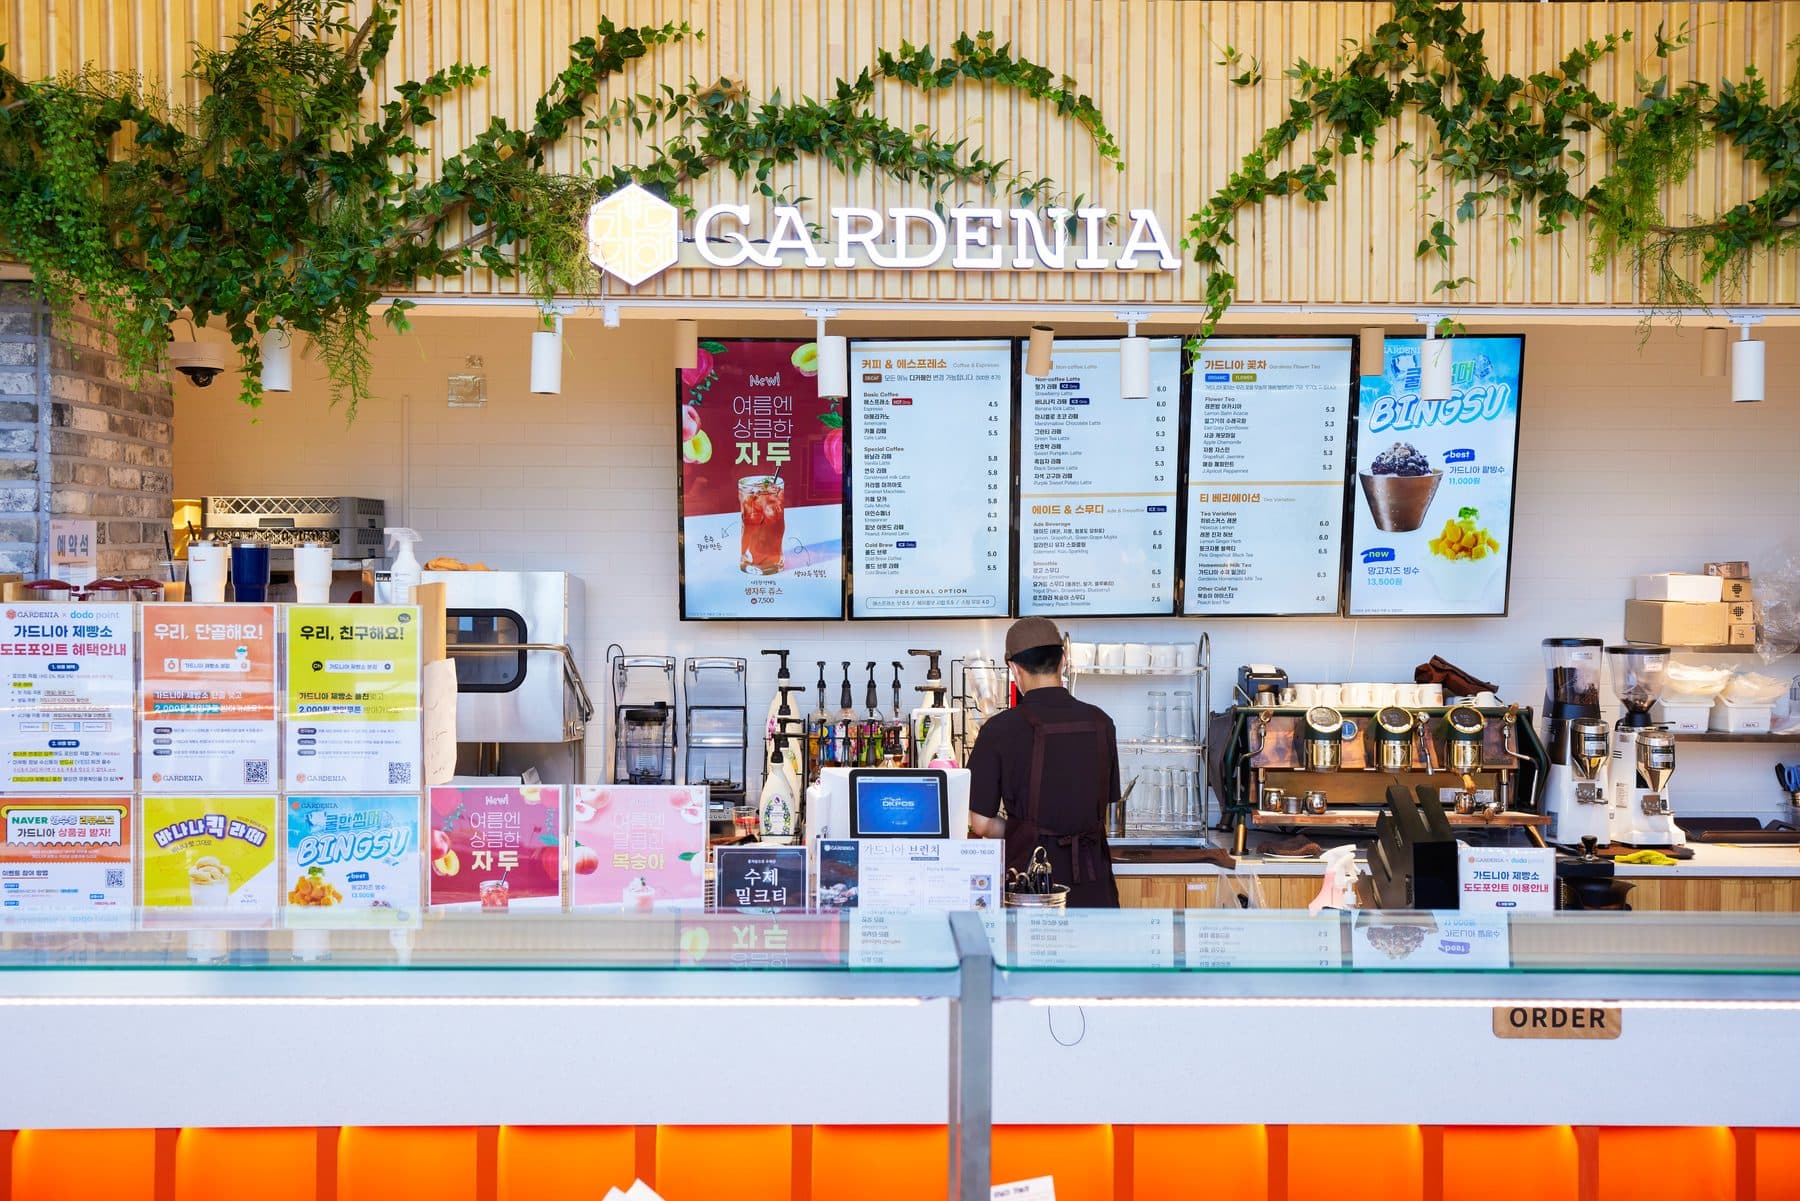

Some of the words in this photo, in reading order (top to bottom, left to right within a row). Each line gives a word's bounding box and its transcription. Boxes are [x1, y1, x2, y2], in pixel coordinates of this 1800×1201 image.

[694, 203, 1182, 271] GARDENIA
[862, 359, 881, 369] 커피
[884, 360, 893, 369] &
[896, 359, 947, 369] 에스프레소
[1205, 360, 1244, 370] 가드니아
[1247, 360, 1267, 370] 꽃차
[733, 395, 793, 416] 여름엔
[1369, 383, 1512, 433] BINGSU
[732, 418, 794, 440] 상큼한
[735, 441, 792, 467] 자두
[1449, 449, 1470, 458] best
[1449, 465, 1480, 475] 가드니아
[1199, 493, 1209, 503] 티
[1212, 493, 1261, 503] 베리에이션
[1032, 505, 1061, 514] 에이드
[1074, 504, 1104, 514] 스무디
[1369, 550, 1390, 558] new
[1367, 565, 1401, 576] 망고치즈
[1403, 565, 1421, 576] 빙수
[768, 588, 784, 596] 쥬스
[17, 611, 59, 619] GARDENIA
[70, 610, 94, 620] dodo
[96, 610, 120, 621] point
[14, 625, 68, 638] 가드니아
[72, 625, 113, 638] 제빵소
[154, 623, 189, 641] 우리,
[195, 623, 264, 641] 단골해요!
[300, 626, 335, 642] 우리,
[339, 625, 405, 641] 친구해요!
[0, 643, 68, 656] 도도포인트
[72, 643, 127, 656] 혜택안내
[299, 692, 329, 701] 가드니아
[11, 816, 48, 825] NAVER
[470, 811, 520, 829] 여름엔
[17, 828, 55, 838] 가드니아
[58, 828, 86, 838] 상품권
[89, 828, 111, 838] 받자!
[154, 814, 227, 848] 바나나킥
[228, 820, 267, 848] 라떼
[297, 826, 410, 867] BINGSU
[470, 831, 520, 849] 상큼한
[908, 843, 940, 857] 브런치
[471, 850, 520, 872] 자두
[612, 853, 665, 872] 복숭아
[743, 867, 779, 887] 수제
[1473, 871, 1510, 881] 가드니아
[1512, 871, 1540, 881] 제빵소
[1464, 883, 1510, 893] 도도포인트
[1512, 883, 1549, 893] 이용안내
[735, 886, 787, 906] 밀크티
[1509, 1006, 1606, 1029] ORDER
